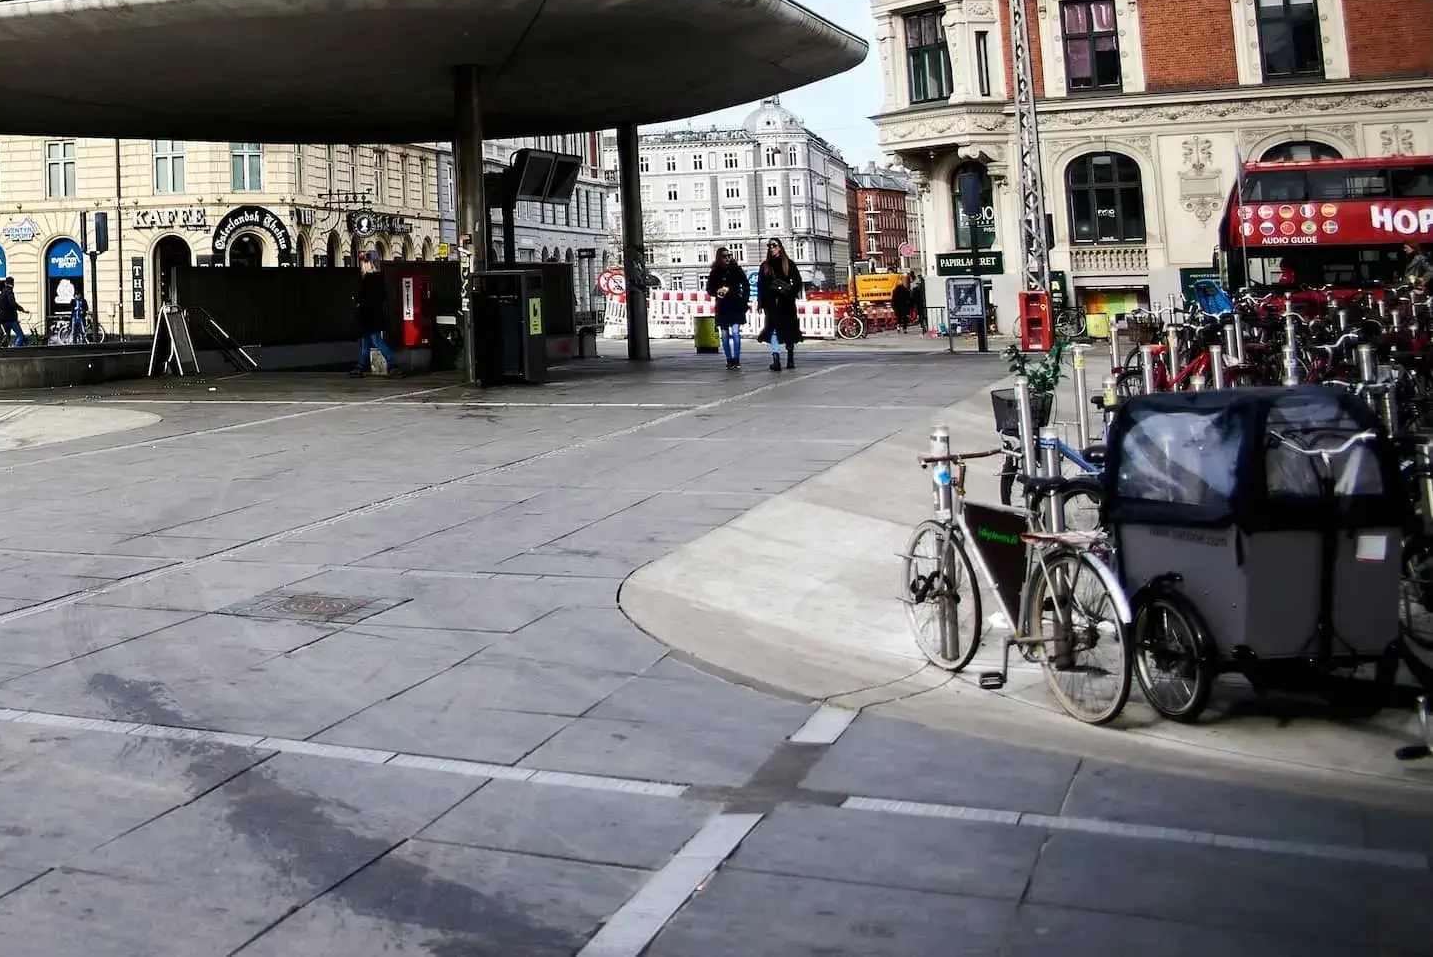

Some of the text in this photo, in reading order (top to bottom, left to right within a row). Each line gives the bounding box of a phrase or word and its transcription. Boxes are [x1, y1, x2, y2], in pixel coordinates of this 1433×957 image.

[133, 208, 206, 227] KAFFE
[1370, 204, 1433, 234] HOP
[940, 257, 996, 268] PAPIRLARET
[133, 265, 143, 301] THE
